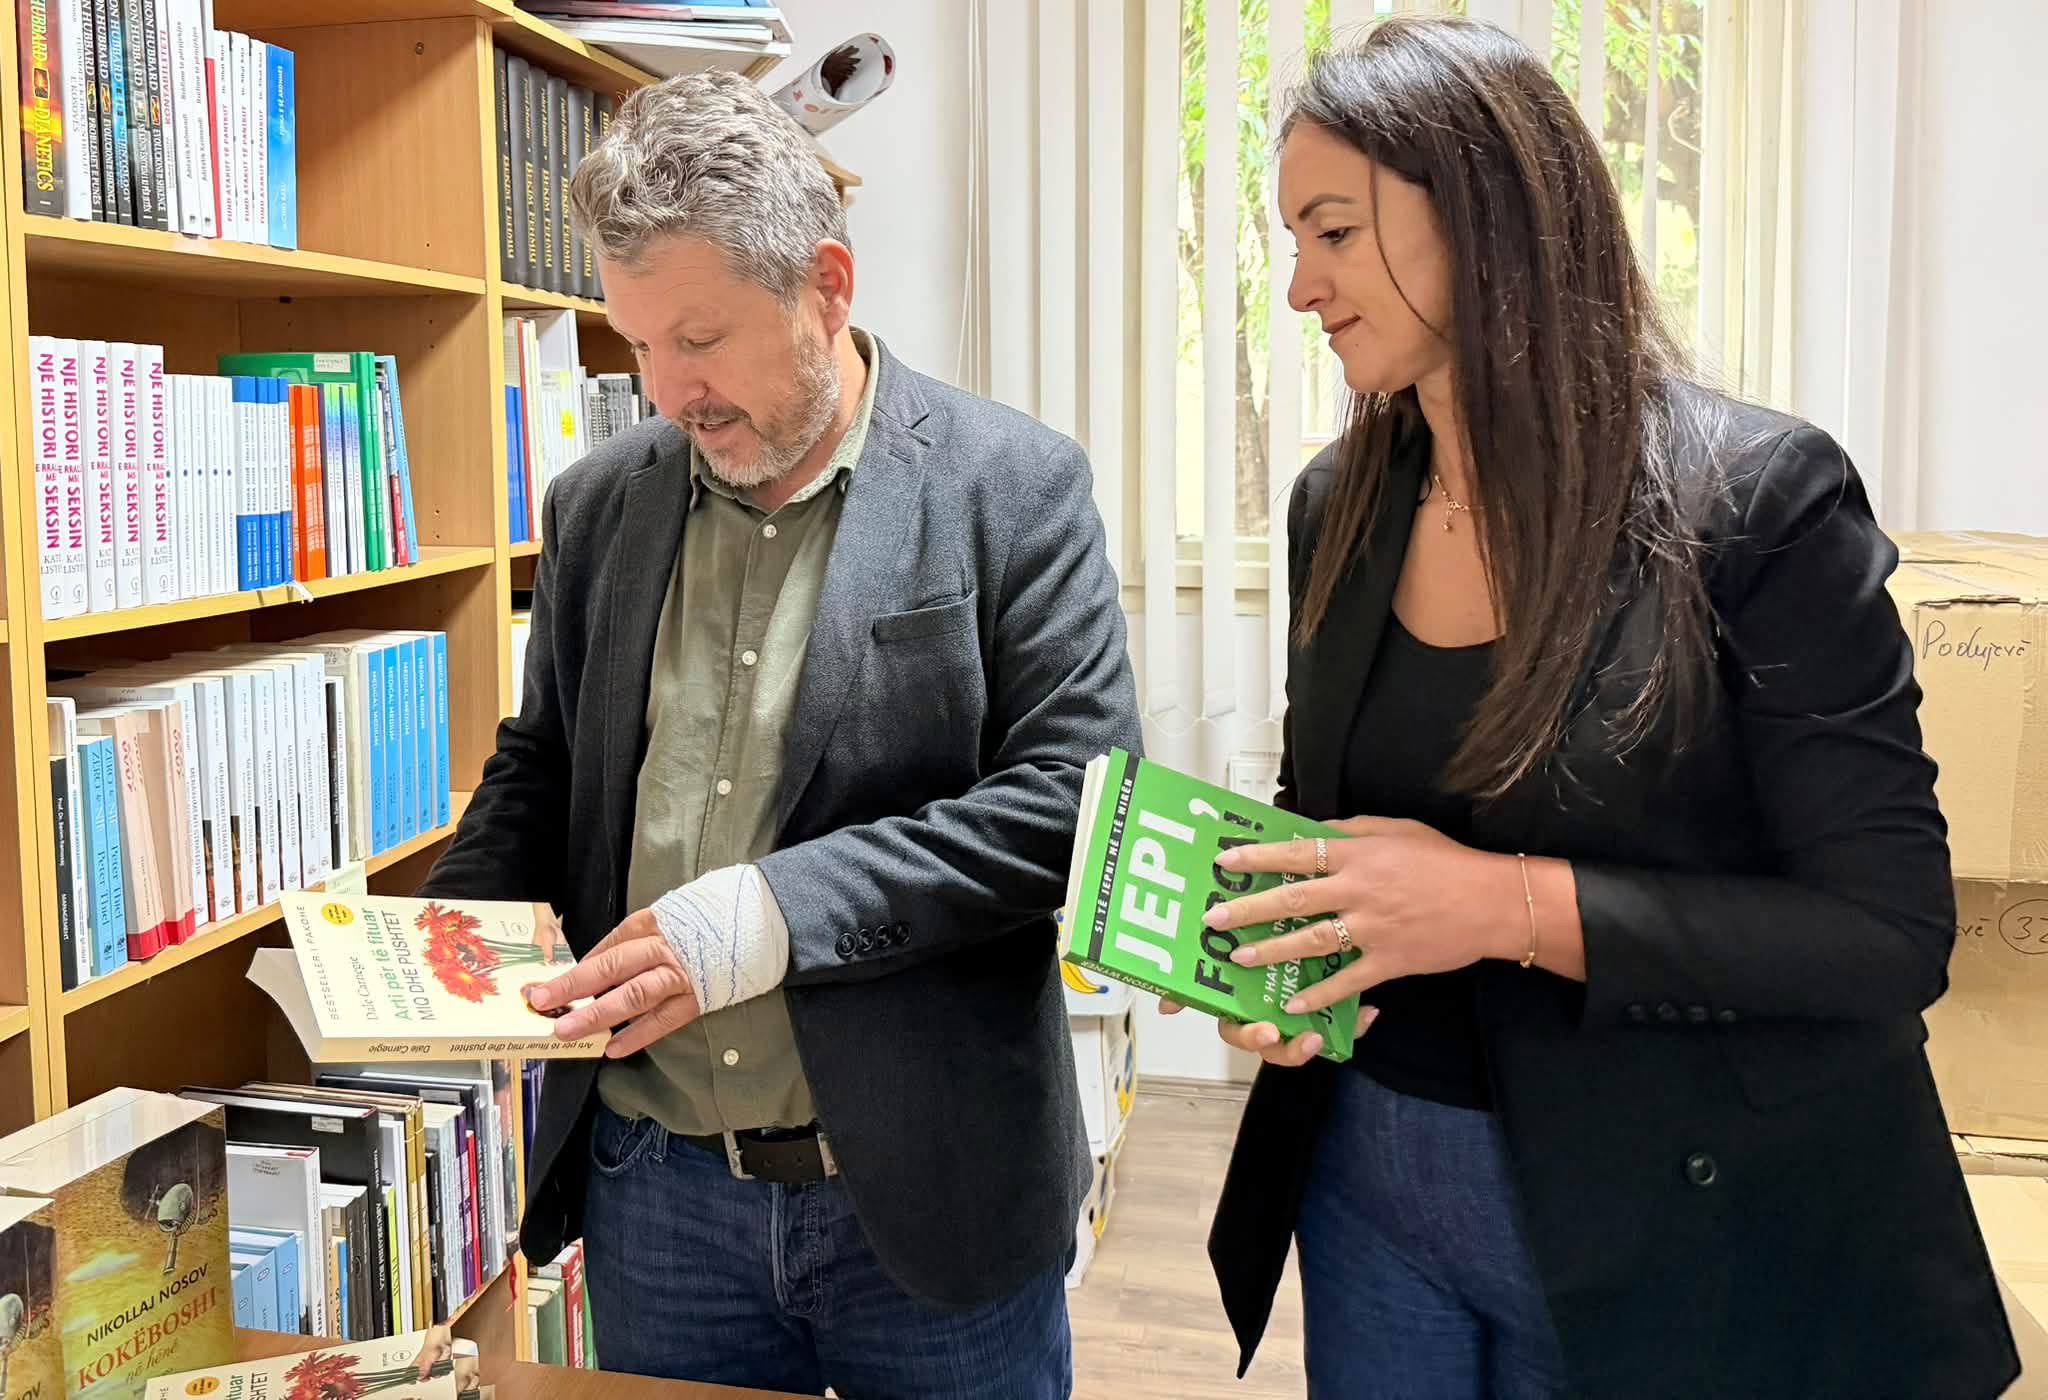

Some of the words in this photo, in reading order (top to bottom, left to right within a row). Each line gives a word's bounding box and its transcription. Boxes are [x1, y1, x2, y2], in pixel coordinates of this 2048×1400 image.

[146, 29, 159, 91] HUBBARD
[33, 101, 54, 192] DIANETICS
[41, 388, 57, 458] HISTORI
[63, 391, 79, 461] HISTORI
[96, 390, 109, 457] HISTORI
[124, 392, 137, 458] HISTORI
[152, 394, 164, 459] HISTORI
[45, 485, 60, 549] SEKSIN
[67, 487, 82, 548] SEKSIN
[100, 483, 112, 543] SEKSIN
[126, 483, 139, 542] SEKSIN
[155, 483, 167, 541] SEKSIN
[1114, 797, 1220, 974] JEPI,
[362, 908, 382, 945] fituar
[371, 946, 388, 963] të
[381, 910, 415, 967] PUSHTET
[382, 966, 400, 994] për
[387, 995, 411, 1020] Arti
[404, 968, 427, 994] DHE
[412, 997, 437, 1021] MIQ
[87, 1295, 155, 1346] NIKOLLAJ
[158, 1263, 209, 1304] NOSOV
[78, 1286, 217, 1391] KOKËBOSHI
